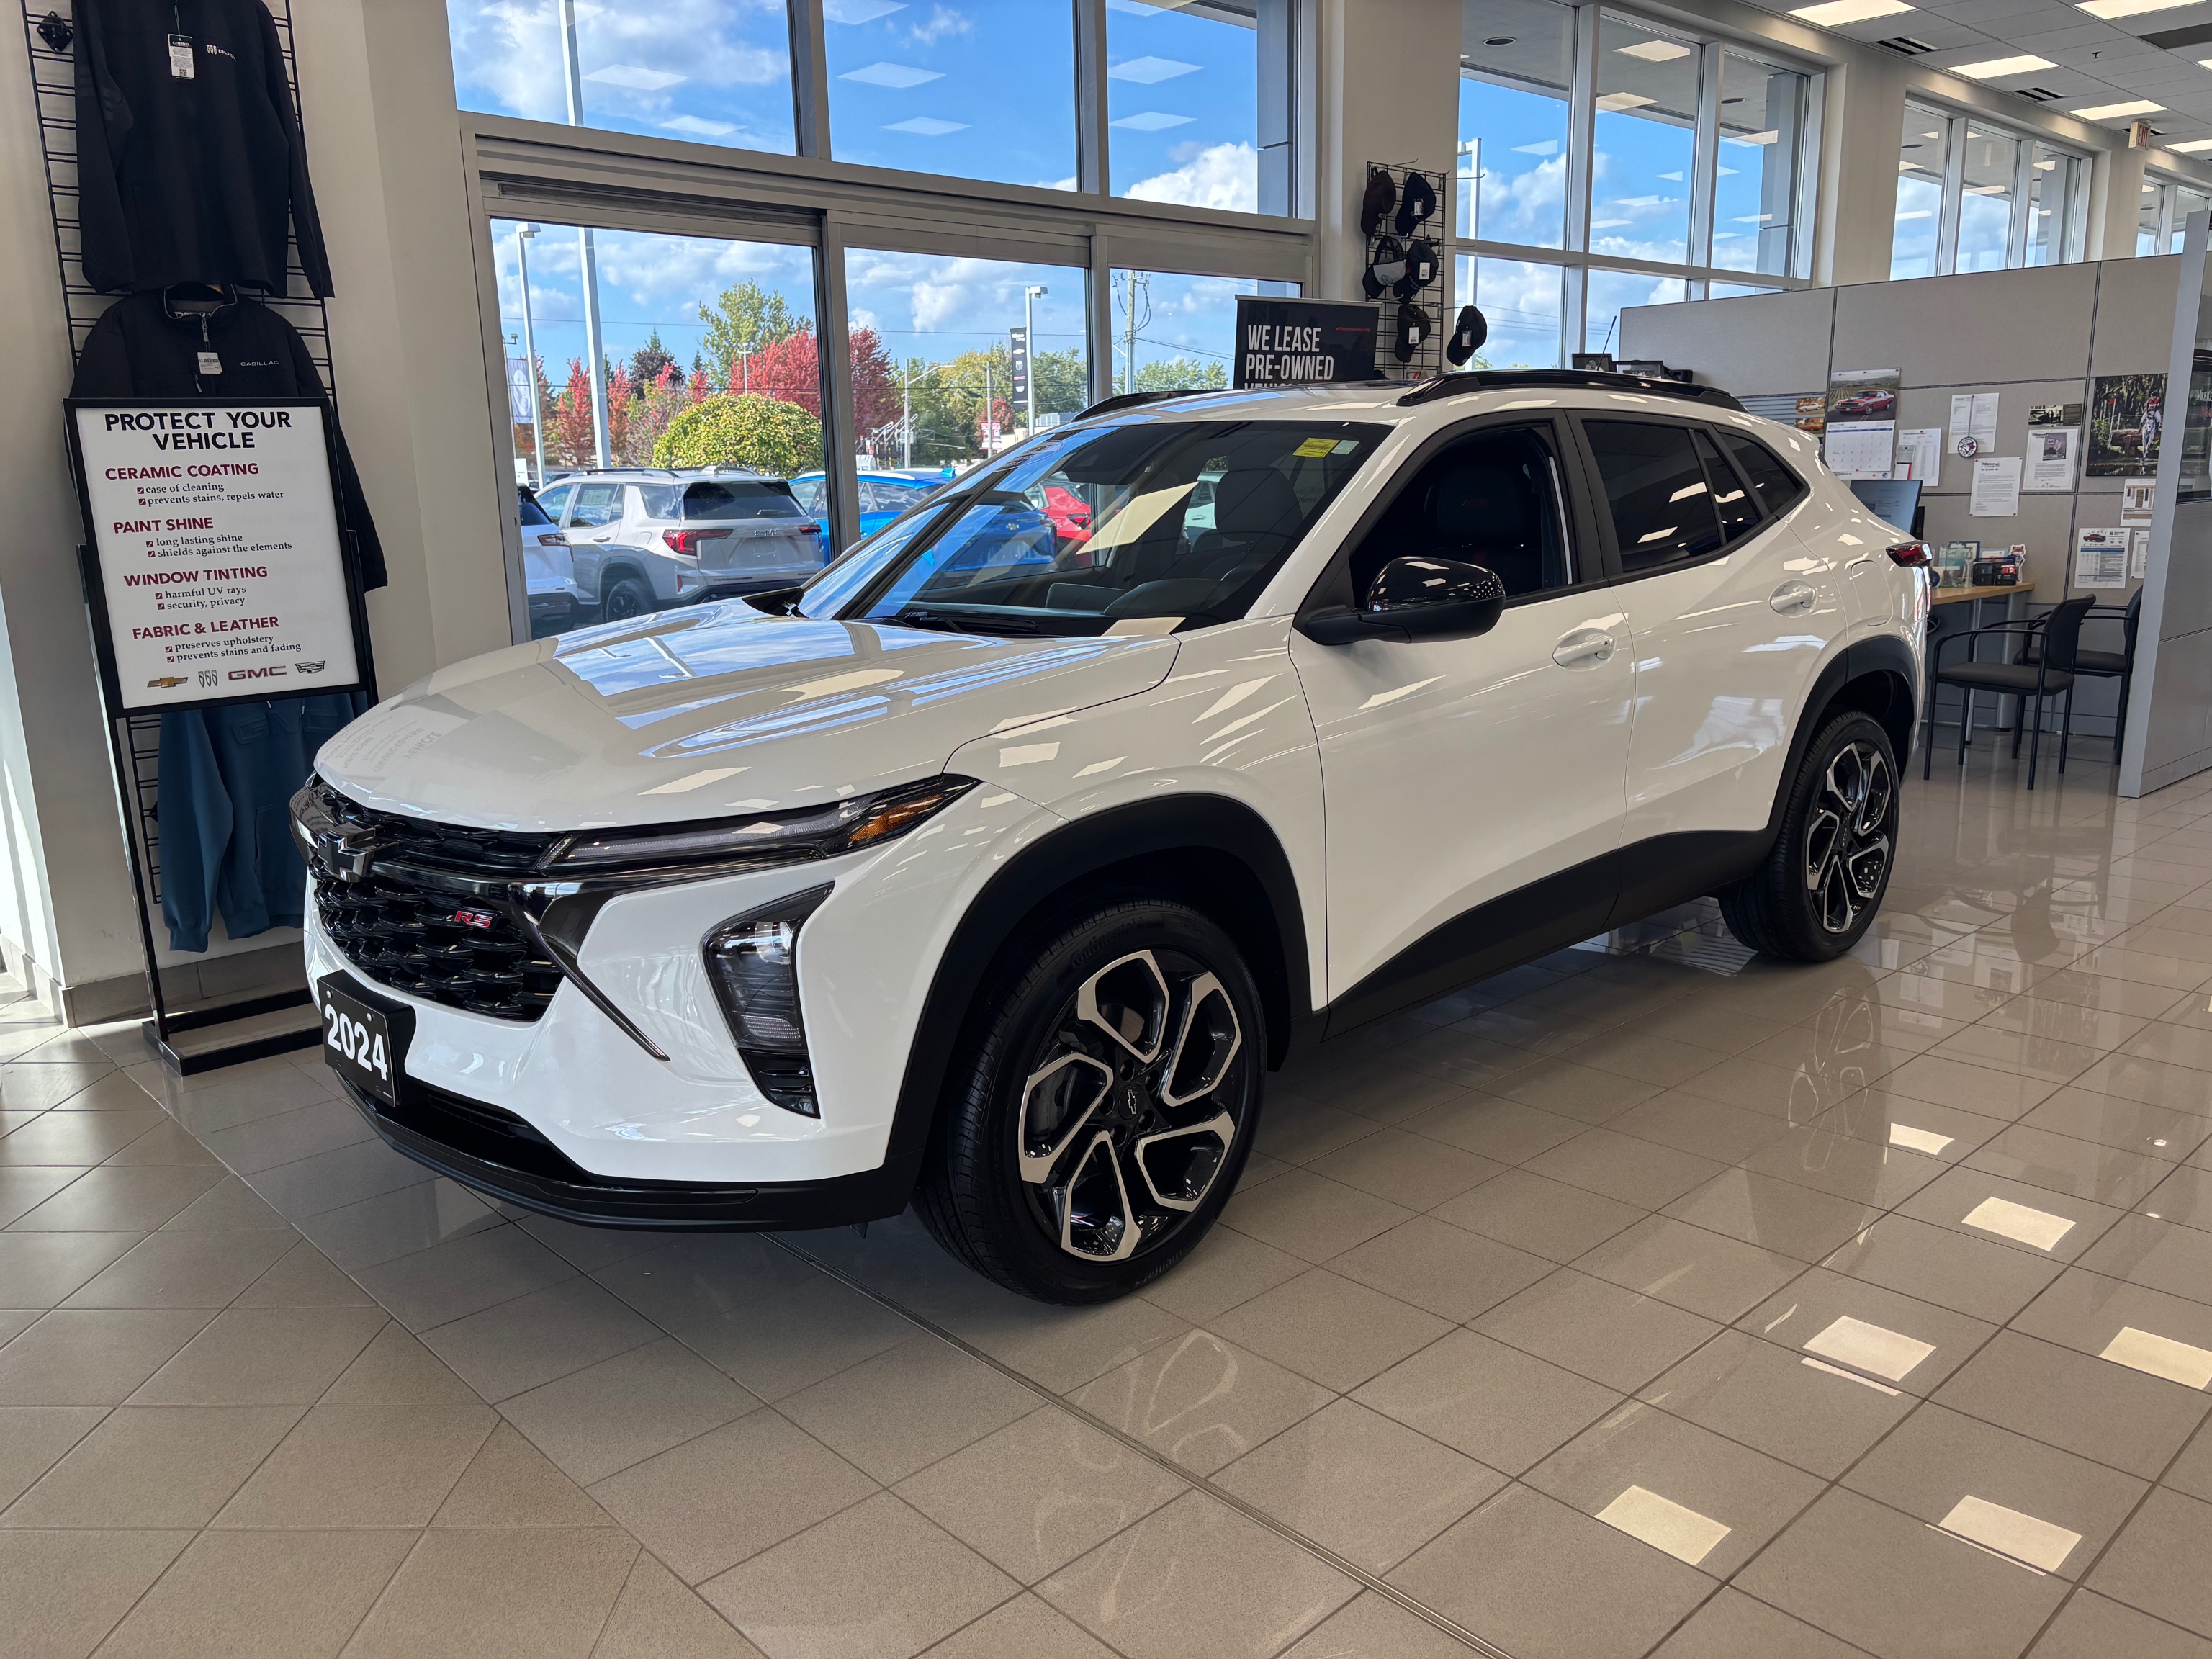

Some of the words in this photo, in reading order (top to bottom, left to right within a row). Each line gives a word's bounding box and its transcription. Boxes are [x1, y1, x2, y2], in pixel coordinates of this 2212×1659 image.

[2138, 125, 2149, 148] EXIT
[1248, 325, 1271, 351] WE
[1274, 325, 1321, 352] LEASE
[1246, 354, 1334, 380] PRE-OWNED
[105, 412, 215, 431] PROTECT
[226, 411, 292, 428] YOUR
[153, 432, 255, 450] VEHICLE
[105, 466, 182, 480] CERAMIC
[187, 463, 259, 477] COATING
[170, 484, 180, 493] of
[182, 482, 224, 493] cleaning
[148, 495, 190, 506] prevents
[193, 493, 225, 503] stains,
[227, 491, 255, 501] repels
[258, 490, 284, 499] water
[114, 519, 161, 534] PAINT
[166, 517, 214, 531] SHINE
[156, 537, 179, 547] long
[181, 535, 215, 545] lasting
[216, 533, 243, 542] shine
[158, 547, 194, 557] shields
[196, 545, 230, 555] against
[233, 544, 248, 552] the
[251, 541, 292, 552] elements
[124, 570, 199, 586] WINDOW
[203, 566, 268, 581] TINTING
[166, 588, 205, 598] harmful
[207, 586, 223, 595] UV
[227, 585, 246, 595] rays
[167, 600, 207, 610] security,
[210, 596, 245, 607] privacy
[132, 623, 190, 639] FABRIC
[194, 622, 207, 634] &
[210, 616, 279, 632] LEATHER
[175, 639, 220, 652] preserves
[223, 635, 274, 647] upholstery
[177, 651, 218, 662] prevents
[220, 648, 248, 657] stains
[251, 644, 269, 654] and
[271, 642, 302, 652] fading
[228, 665, 287, 680] GMC
[454, 911, 493, 928] RS
[325, 1004, 388, 1081] 2024
